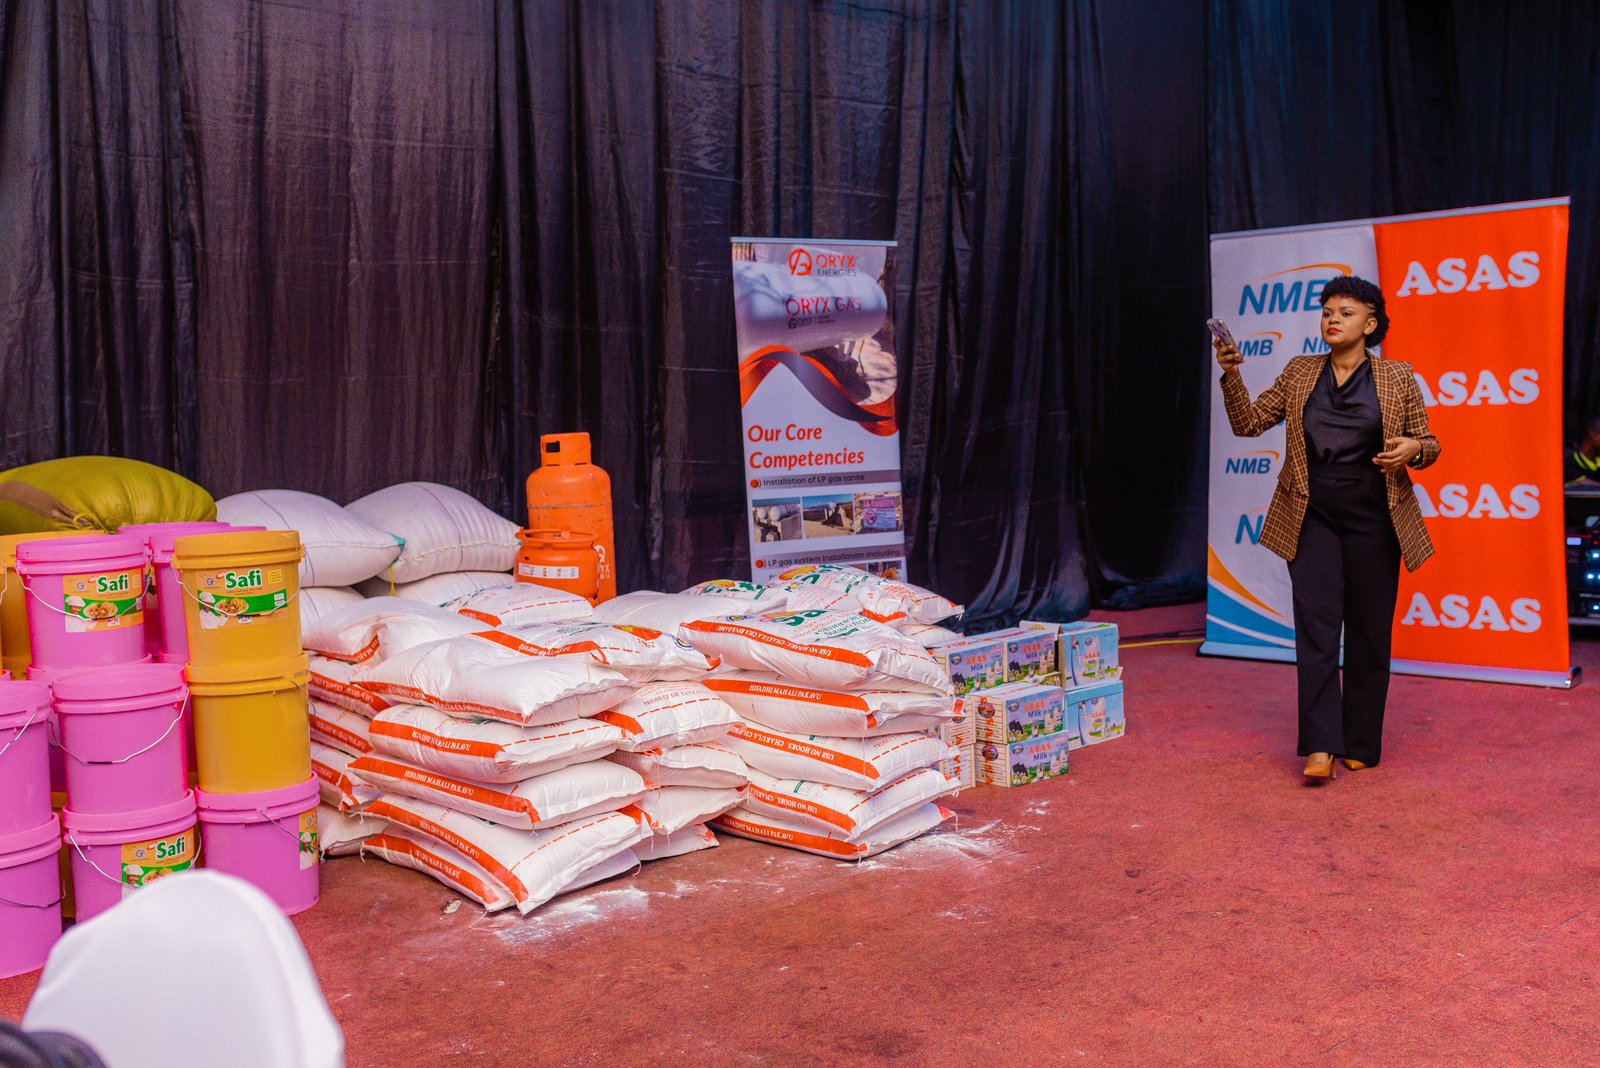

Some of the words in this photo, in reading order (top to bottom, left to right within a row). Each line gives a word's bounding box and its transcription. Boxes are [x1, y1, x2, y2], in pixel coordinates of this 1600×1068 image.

[816, 253, 856, 269] ORYX
[816, 268, 857, 278] ENERGIES
[1396, 251, 1540, 298] ASAS
[785, 296, 832, 316] ORYX
[834, 296, 862, 312] GAS
[747, 424, 782, 442] Our
[785, 423, 823, 441] Core
[749, 447, 865, 471] Competencies
[1225, 457, 1271, 474] NMB
[763, 477, 807, 486] Installation
[808, 476, 816, 484] of
[818, 475, 827, 483] LP
[828, 476, 842, 484] gas
[843, 474, 865, 482] tanks
[768, 559, 778, 567] LP
[779, 558, 793, 568] gas
[794, 556, 821, 566] system
[96, 573, 129, 593] Safi
[225, 569, 262, 589] Safi
[1400, 591, 1542, 633] ASAS
[745, 628, 758, 638] CHA
[757, 632, 786, 645] CHAKULA
[819, 648, 832, 657] USE
[1022, 642, 1041, 654] ASAS
[966, 653, 988, 666] ASAS
[748, 684, 774, 694] HIFADHI
[773, 687, 798, 698] MAHALI
[797, 690, 822, 701] PAKAVU
[1024, 700, 1046, 712] ASAS
[1028, 709, 1042, 719] Milk
[753, 732, 785, 747] CHAKULA
[810, 749, 822, 757] NO
[1028, 742, 1052, 755] ASAS
[821, 752, 835, 761] USE
[1033, 751, 1048, 762] Milk
[403, 769, 428, 782] HIFADHI
[427, 776, 451, 790] MAHALI
[450, 783, 475, 796] PAKAVU
[796, 802, 807, 810] NO
[745, 825, 770, 836] MAHALI
[770, 830, 794, 841] PAKAVU
[156, 836, 185, 859] Safi
